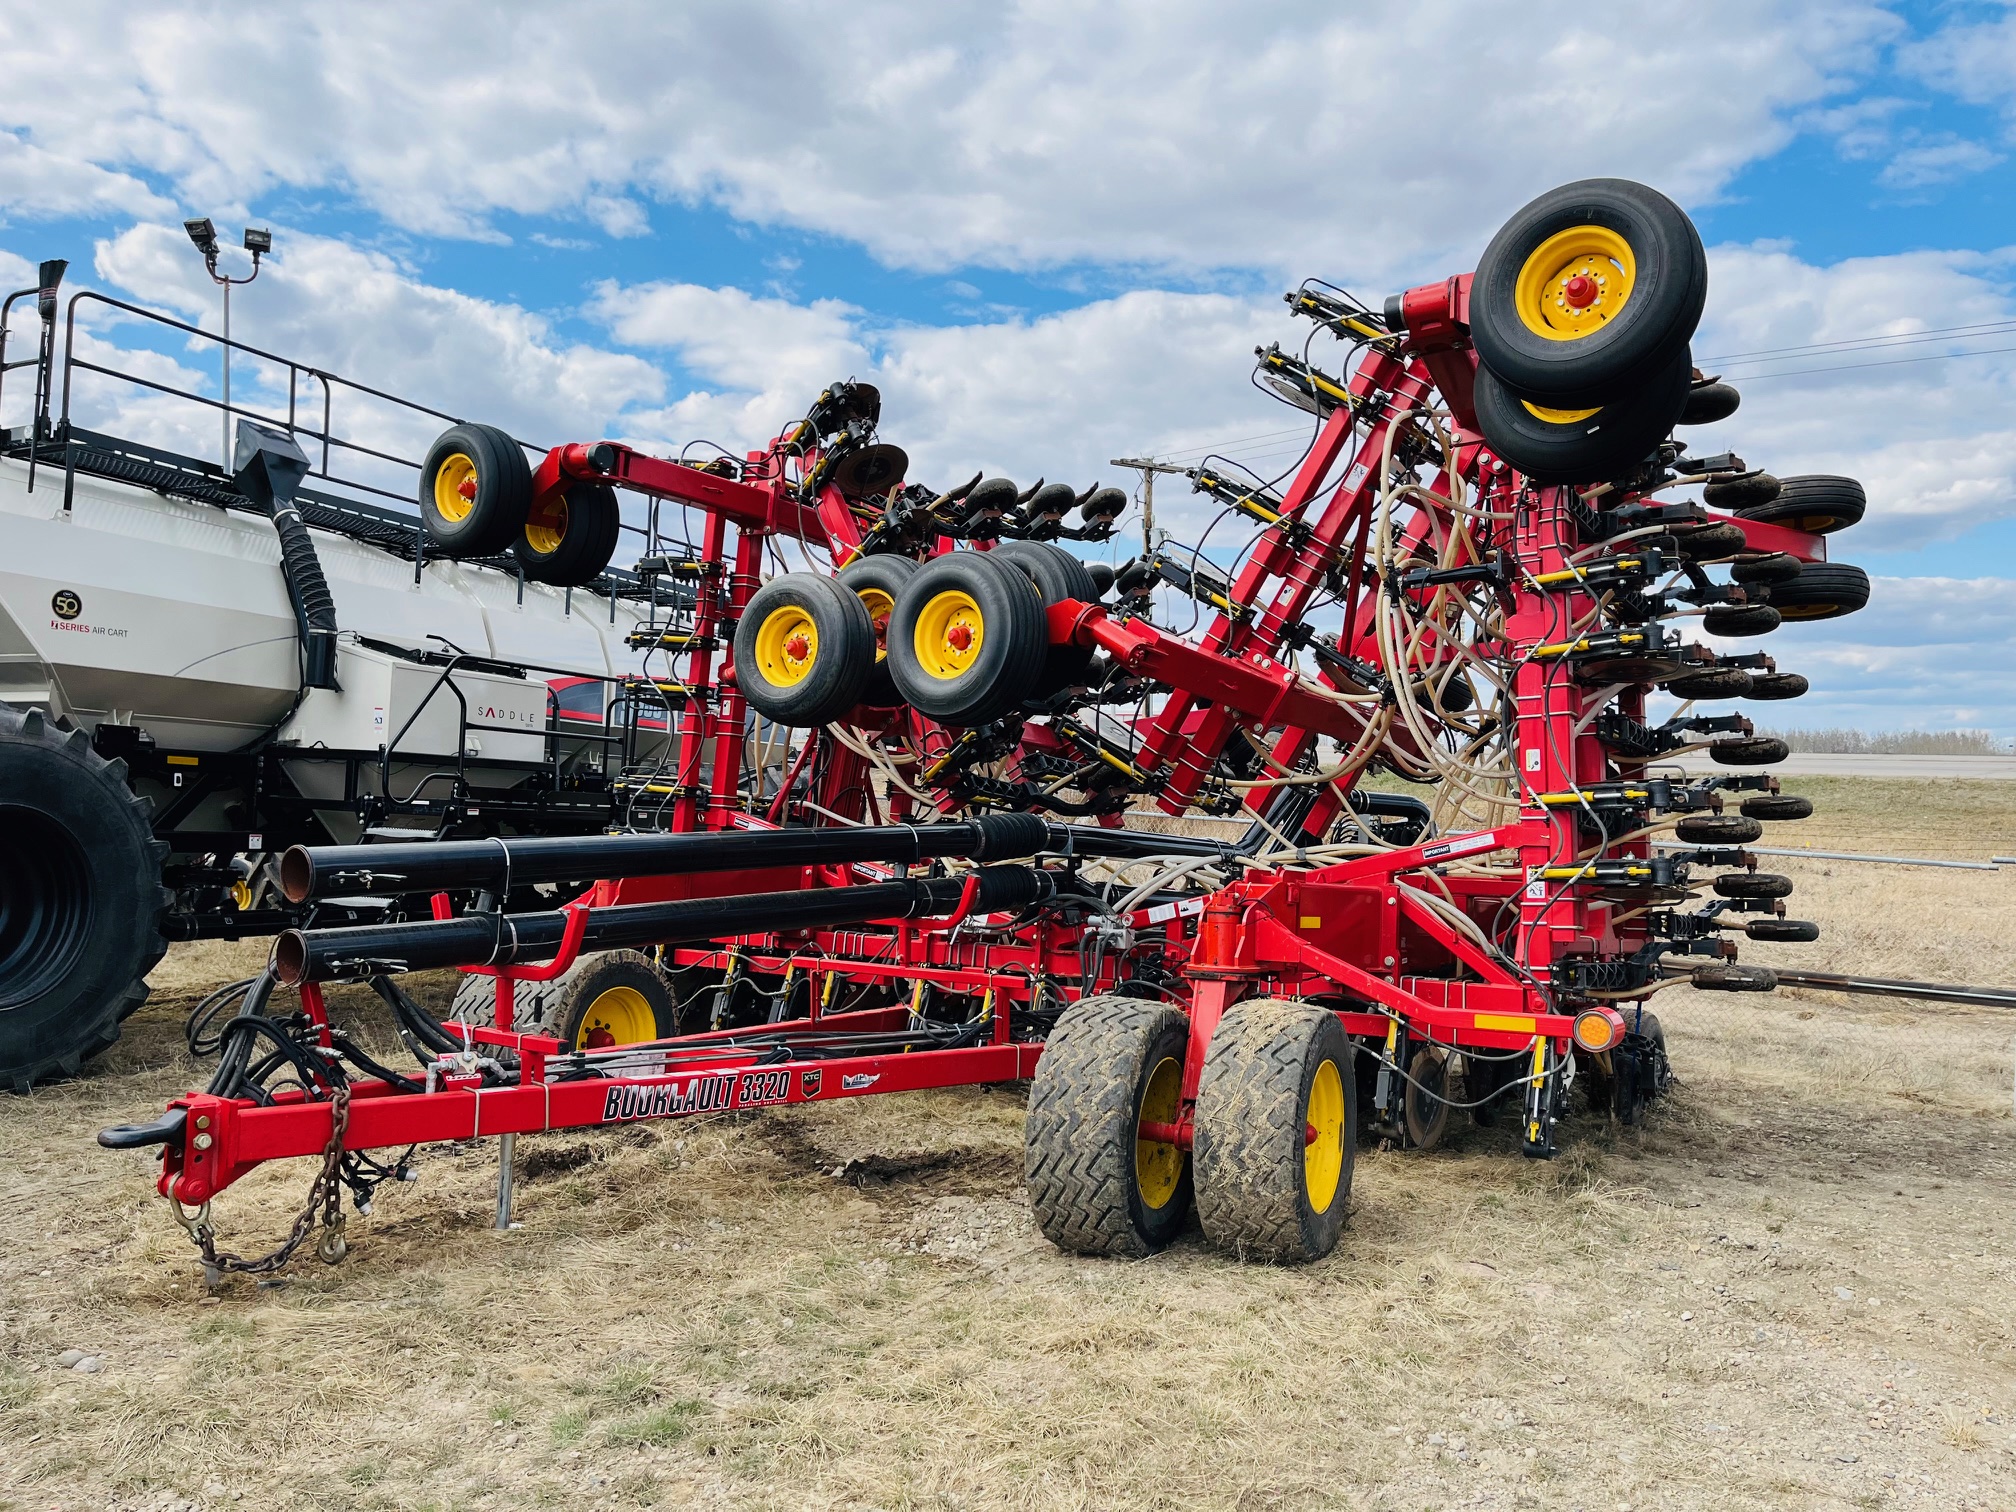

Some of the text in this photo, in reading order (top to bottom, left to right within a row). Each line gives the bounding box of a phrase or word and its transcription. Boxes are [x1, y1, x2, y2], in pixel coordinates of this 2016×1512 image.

[55, 596, 78, 615] 50
[60, 622, 90, 633] SERIES
[92, 626, 106, 635] AIR
[107, 628, 129, 638] CART
[477, 706, 535, 723] SADDLE
[803, 1073, 820, 1081] XTC
[602, 1071, 791, 1121] BOURGAULT 3320
